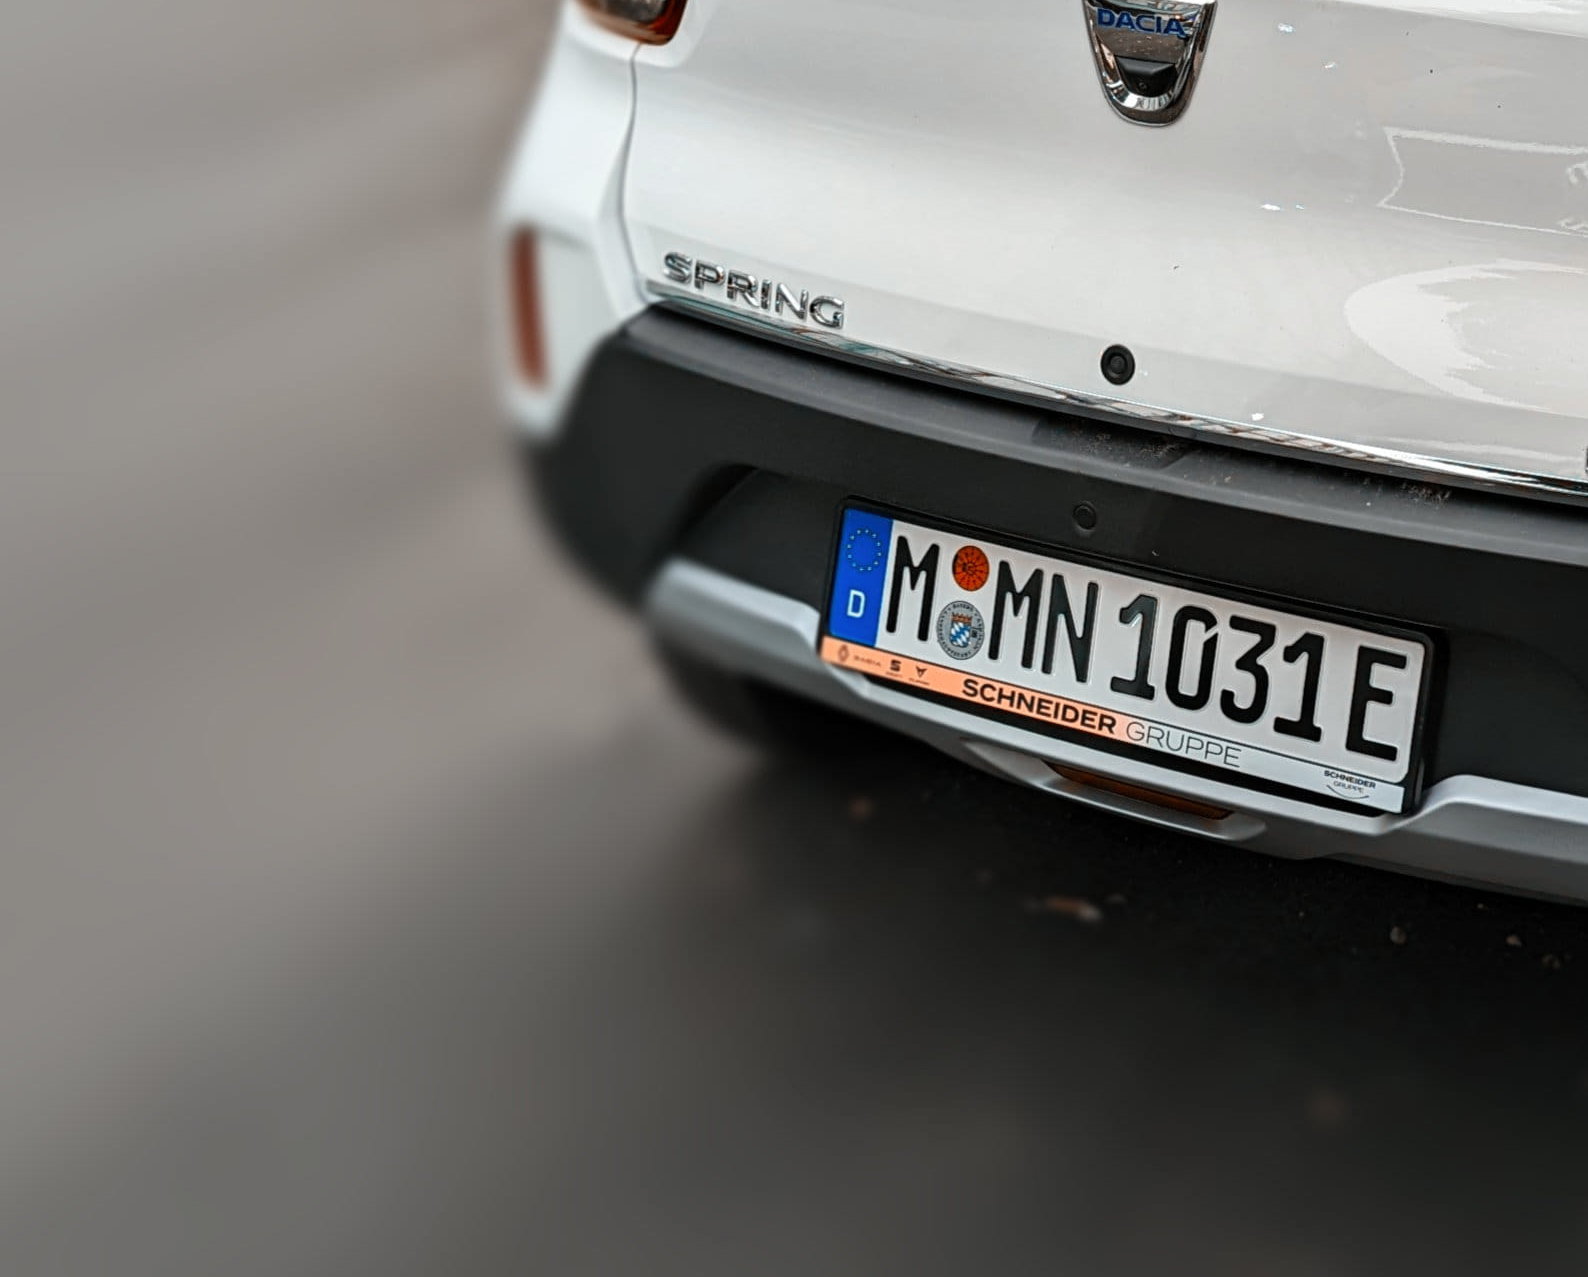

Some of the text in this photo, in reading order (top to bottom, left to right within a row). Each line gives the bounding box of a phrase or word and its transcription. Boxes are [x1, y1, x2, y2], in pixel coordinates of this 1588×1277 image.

[1096, 8, 1188, 40] DACIA
[663, 251, 845, 329] SPRING
[847, 589, 866, 618] D
[886, 535, 940, 642] M
[988, 560, 1099, 684] MN
[961, 678, 1243, 768] SCHNEIDER GRUPPE
[1323, 769, 1377, 790] SCHNEIDER
